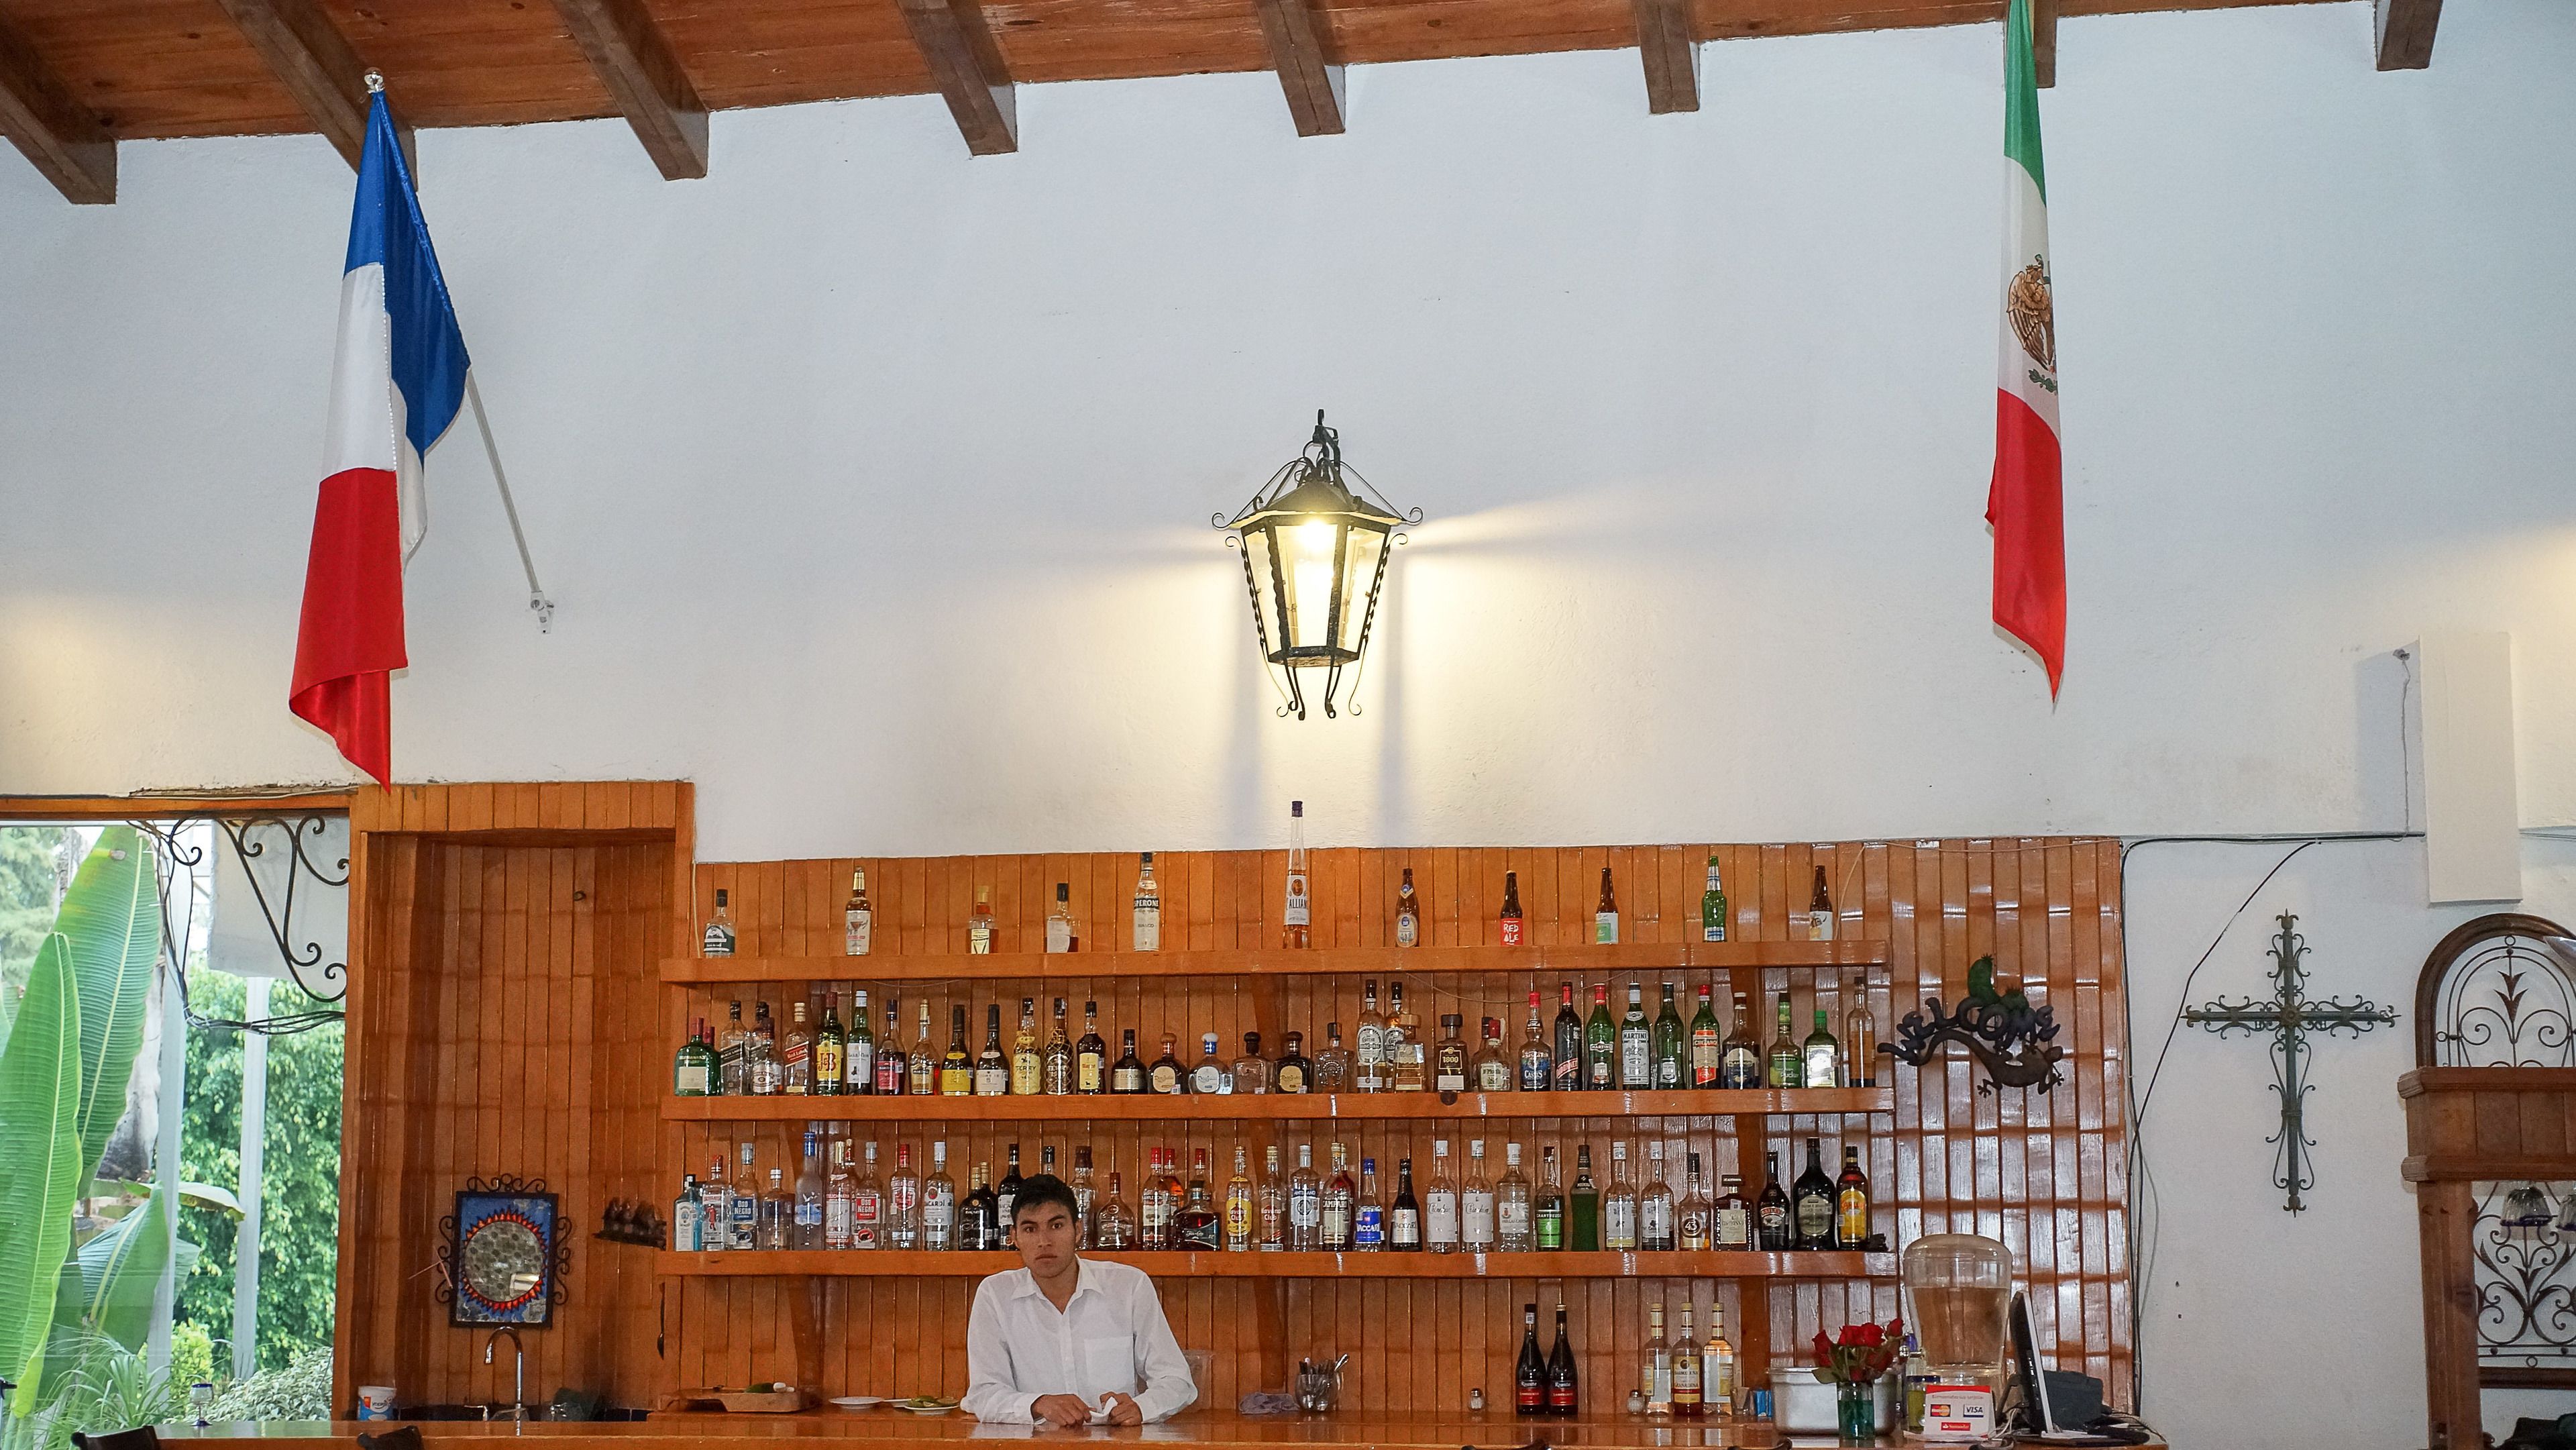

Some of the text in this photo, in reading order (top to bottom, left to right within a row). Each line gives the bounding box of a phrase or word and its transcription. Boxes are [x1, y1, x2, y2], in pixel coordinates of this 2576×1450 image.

[1503, 923, 1519, 933] RED
[1503, 933, 1519, 943] ALE
[818, 1052, 836, 1072] J&B
[1684, 1221, 1697, 1231] 43
